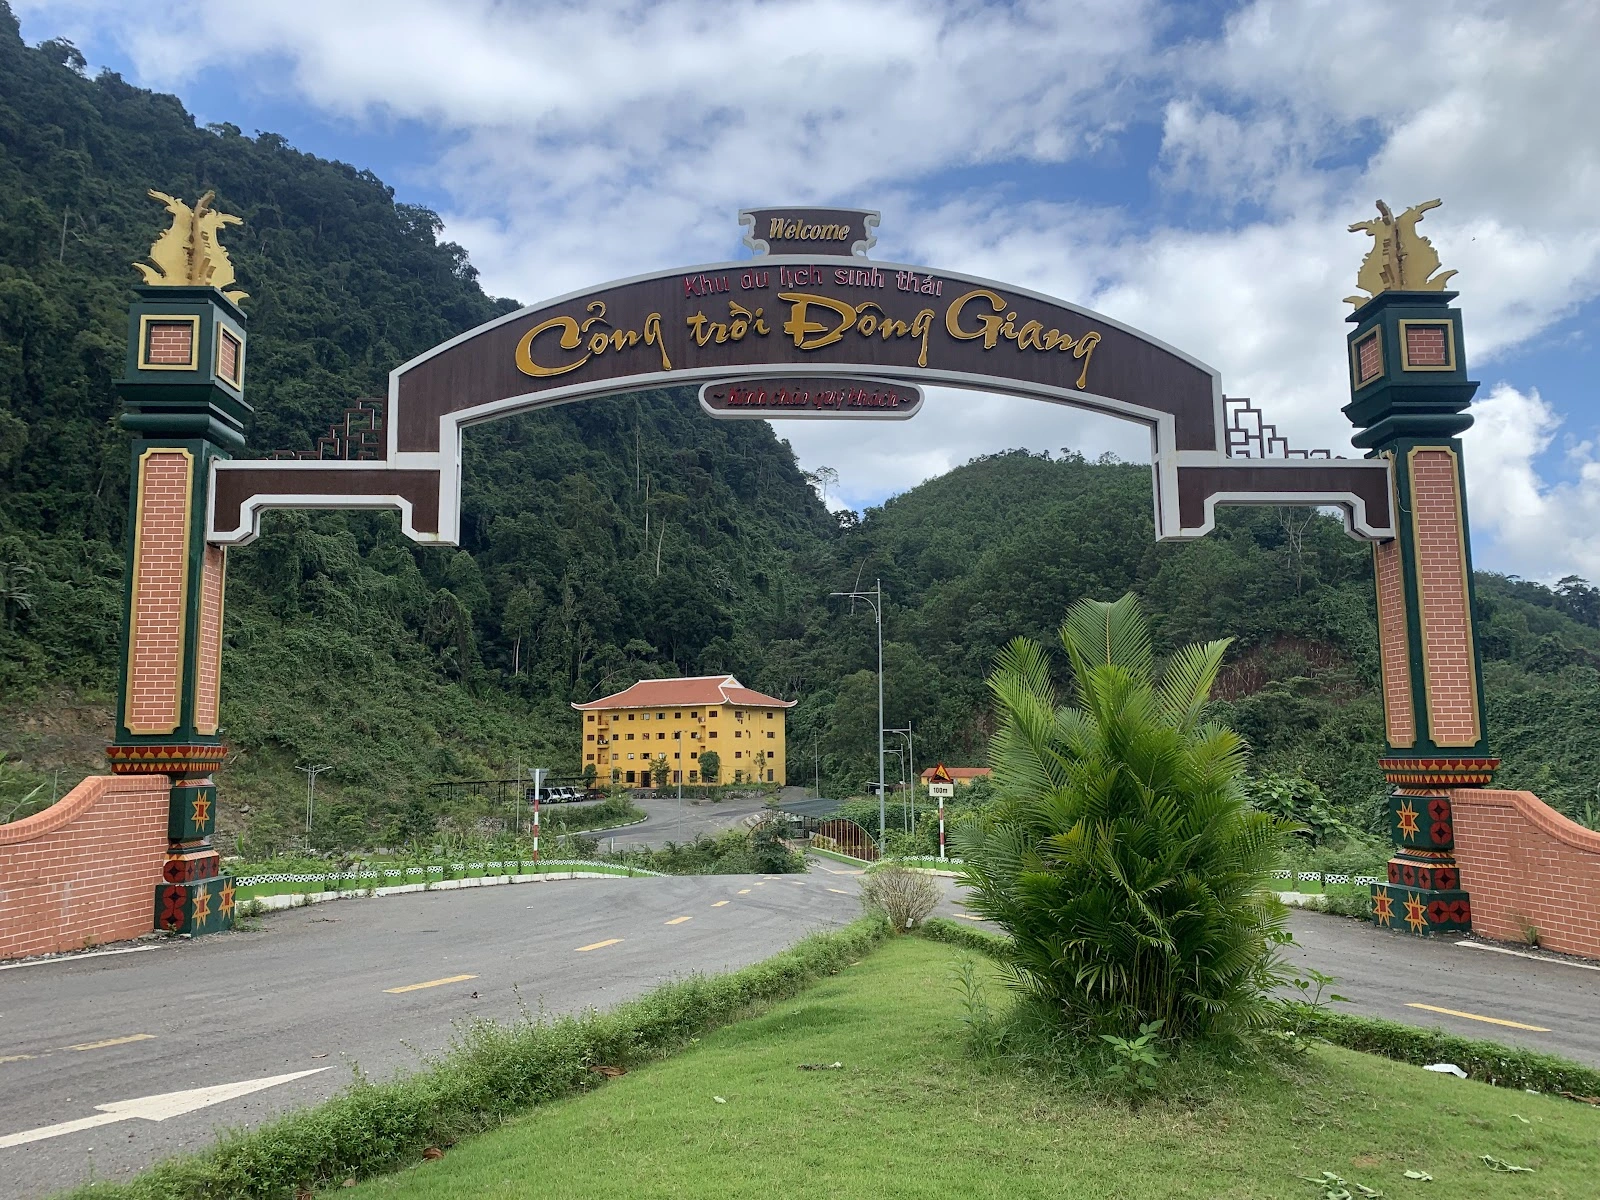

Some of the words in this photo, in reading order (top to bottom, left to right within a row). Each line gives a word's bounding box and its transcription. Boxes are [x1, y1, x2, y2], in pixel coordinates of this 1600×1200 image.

[769, 217, 850, 241] Welcome
[684, 274, 730, 298] Khu
[740, 268, 769, 290] du
[780, 264, 823, 290] lịch
[834, 265, 885, 288] sinh
[896, 269, 942, 297] thái
[515, 301, 672, 377] Cổng
[686, 300, 771, 346] trời
[777, 292, 936, 368] Đông
[946, 289, 1102, 390] Giang
